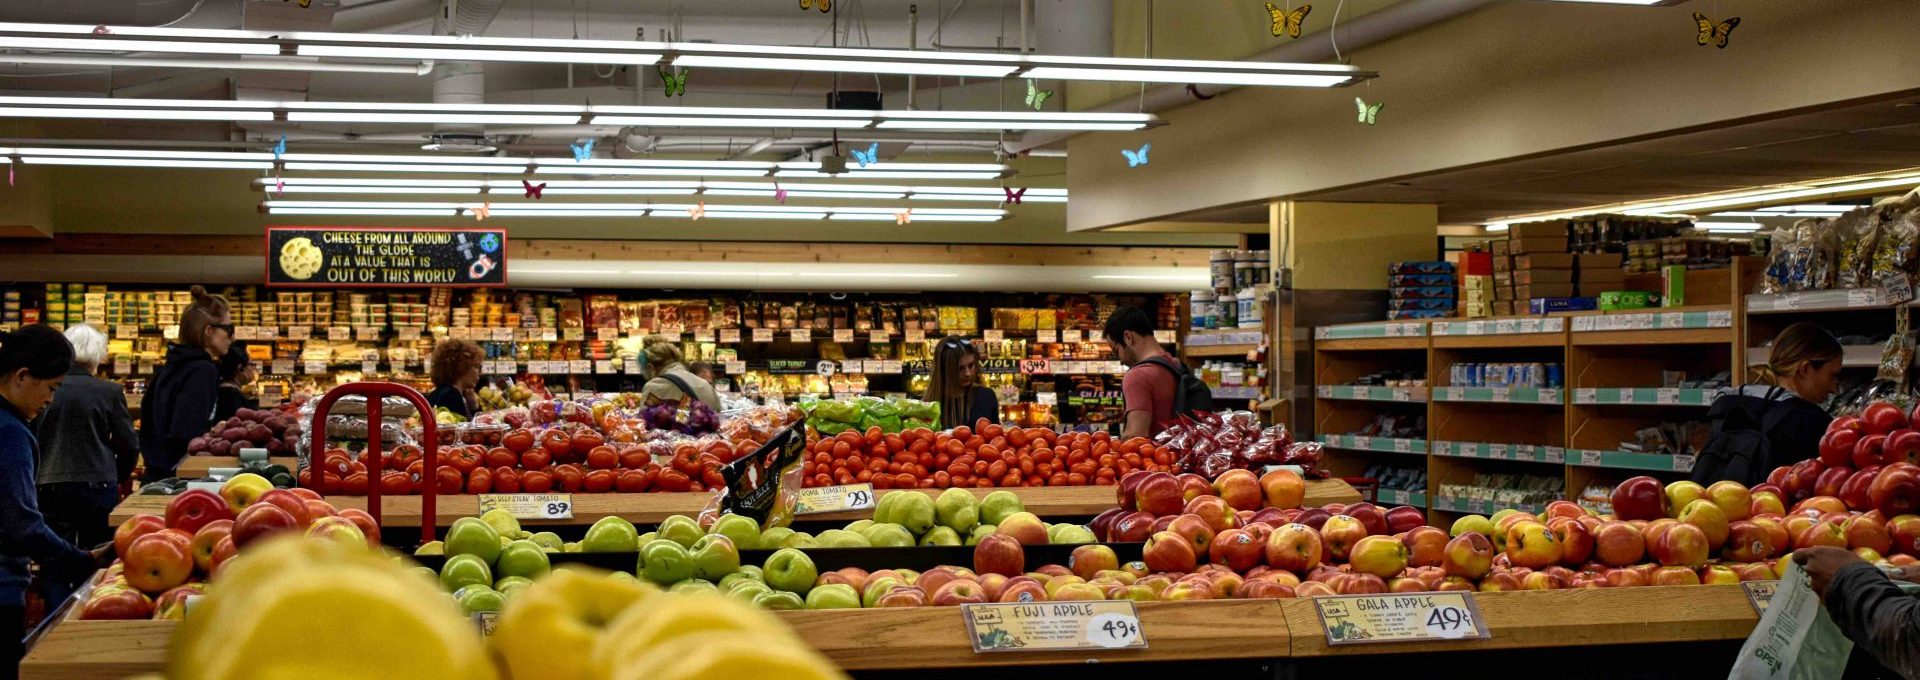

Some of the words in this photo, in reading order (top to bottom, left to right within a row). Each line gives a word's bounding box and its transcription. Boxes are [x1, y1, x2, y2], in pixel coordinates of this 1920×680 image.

[323, 232, 362, 244] CHEESE
[364, 232, 391, 244] FROM
[393, 232, 409, 244] ALL
[412, 232, 451, 244] AROUND
[355, 244, 375, 255] THE
[379, 244, 415, 255] GLOBE
[354, 255, 387, 267] VALUE
[389, 255, 415, 267] THAT
[420, 255, 431, 267] IS
[327, 268, 357, 282] OUT
[359, 268, 376, 282] OF
[383, 268, 410, 282] THIS
[413, 268, 456, 282] WORLD
[823, 486, 847, 495] TOMATO
[1013, 606, 1045, 618] FUJI
[1053, 603, 1094, 616] APPLE
[1357, 598, 1388, 611] GALA
[1394, 596, 1436, 609] APPLE
[1427, 606, 1472, 631] 49¢
[1102, 620, 1137, 640] 49¢
[1755, 648, 1782, 671] OPEN
